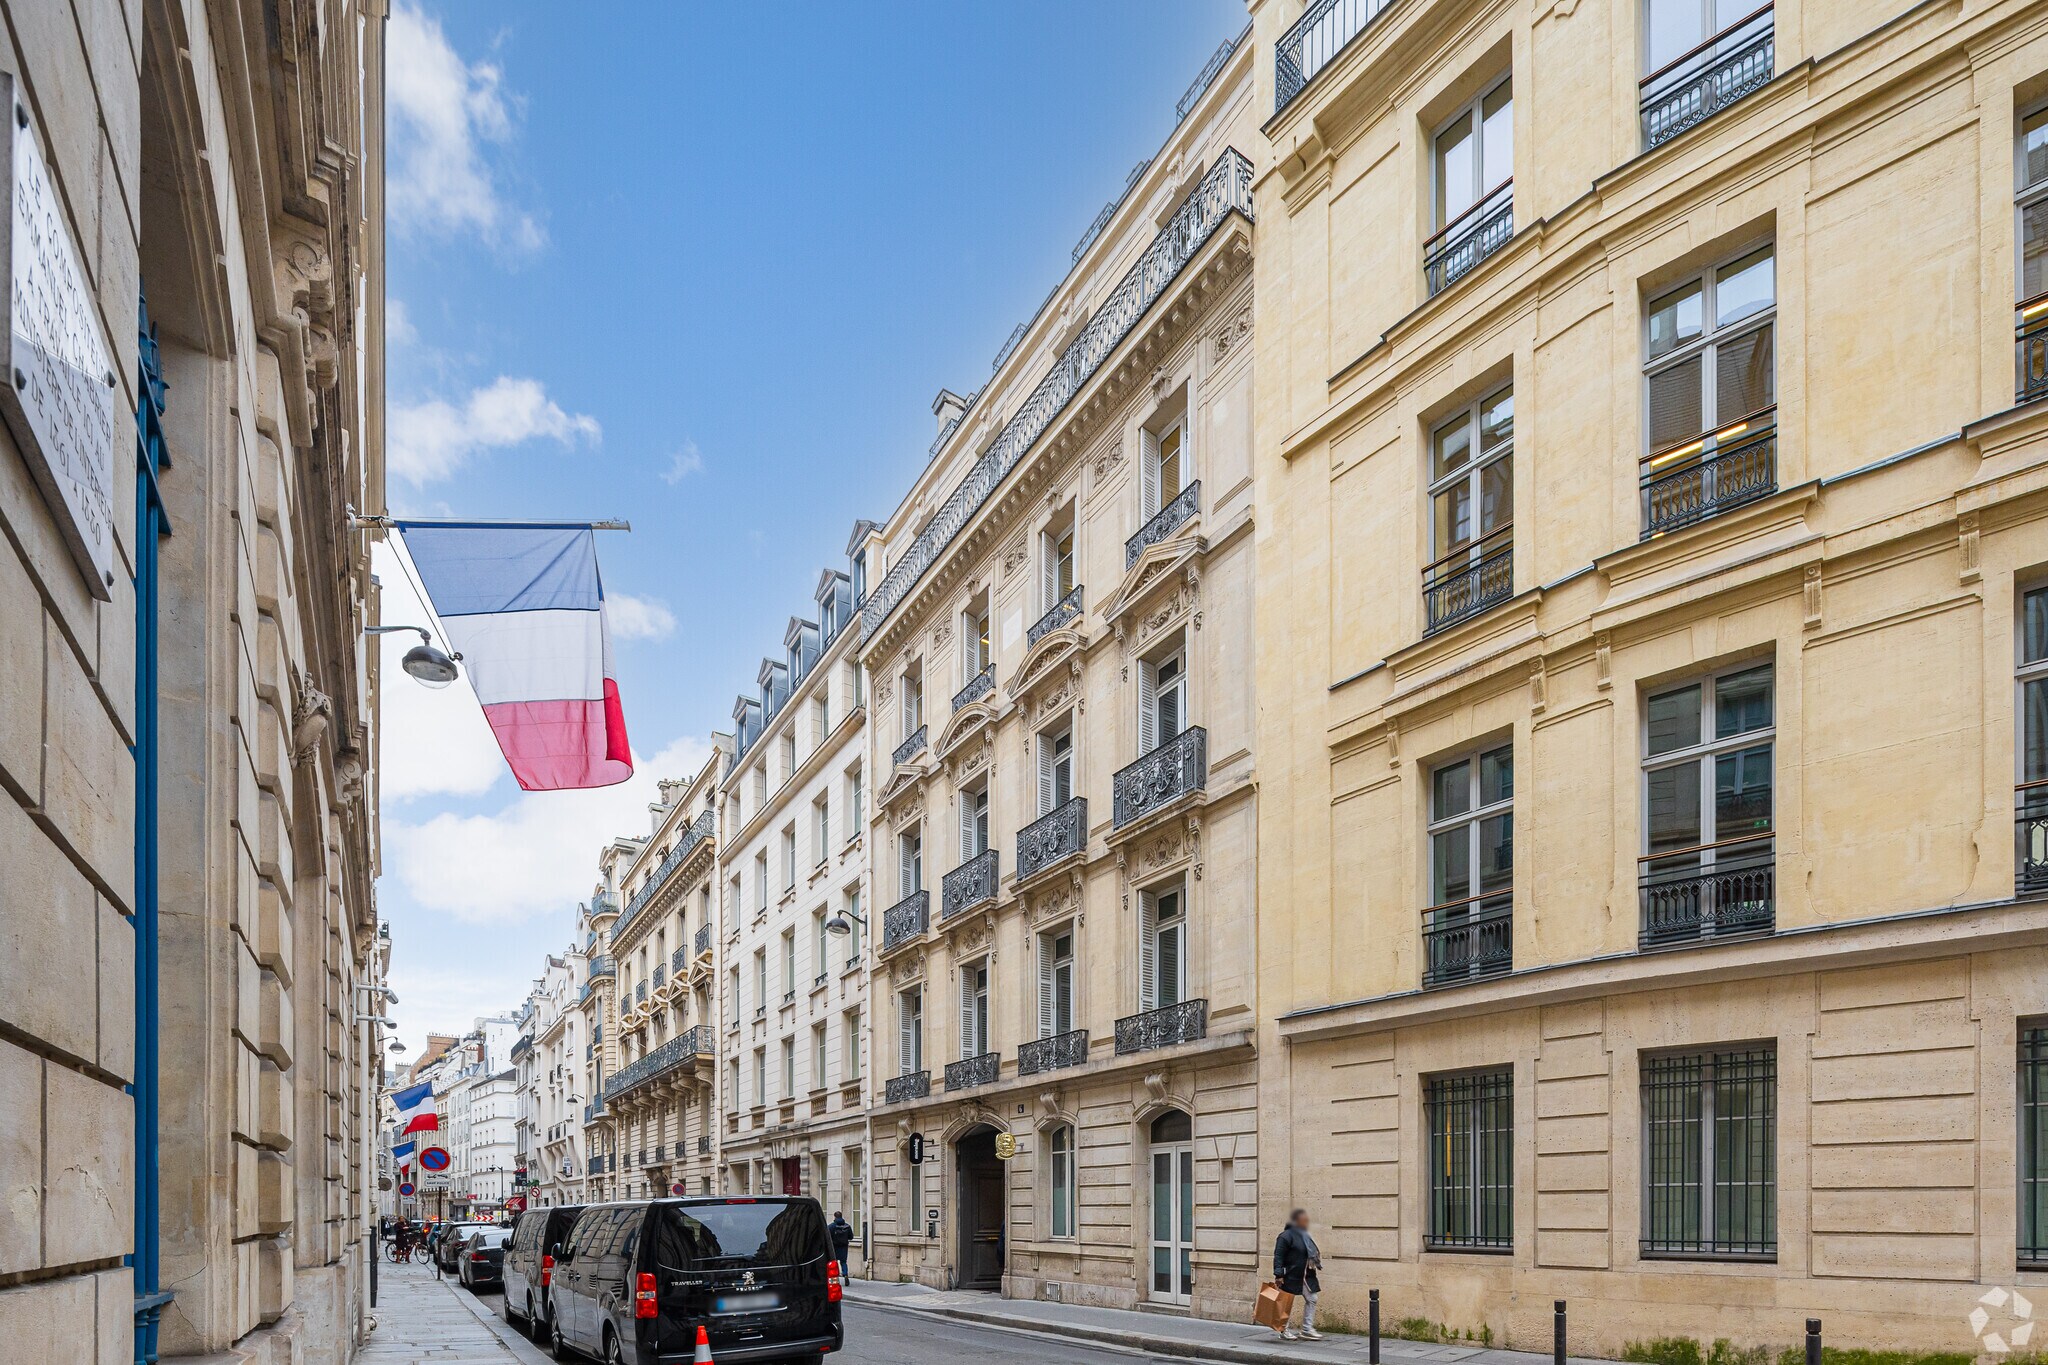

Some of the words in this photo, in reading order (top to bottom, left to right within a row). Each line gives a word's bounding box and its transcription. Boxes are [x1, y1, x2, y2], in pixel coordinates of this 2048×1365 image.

[14, 277, 62, 414] MINISTERE
[18, 181, 69, 339] EMMANUEL
[72, 331, 111, 450] CHABRIER
[27, 264, 34, 296] A
[37, 285, 80, 414] TRAVAILLE
[83, 403, 93, 446] ICI
[94, 437, 104, 472] AU
[28, 154, 41, 211] LE
[46, 211, 106, 394] COMPOSITEUR
[31, 370, 43, 419] DE
[49, 413, 69, 478] 1861
[73, 480, 78, 499] A
[81, 487, 101, 547] 1880
